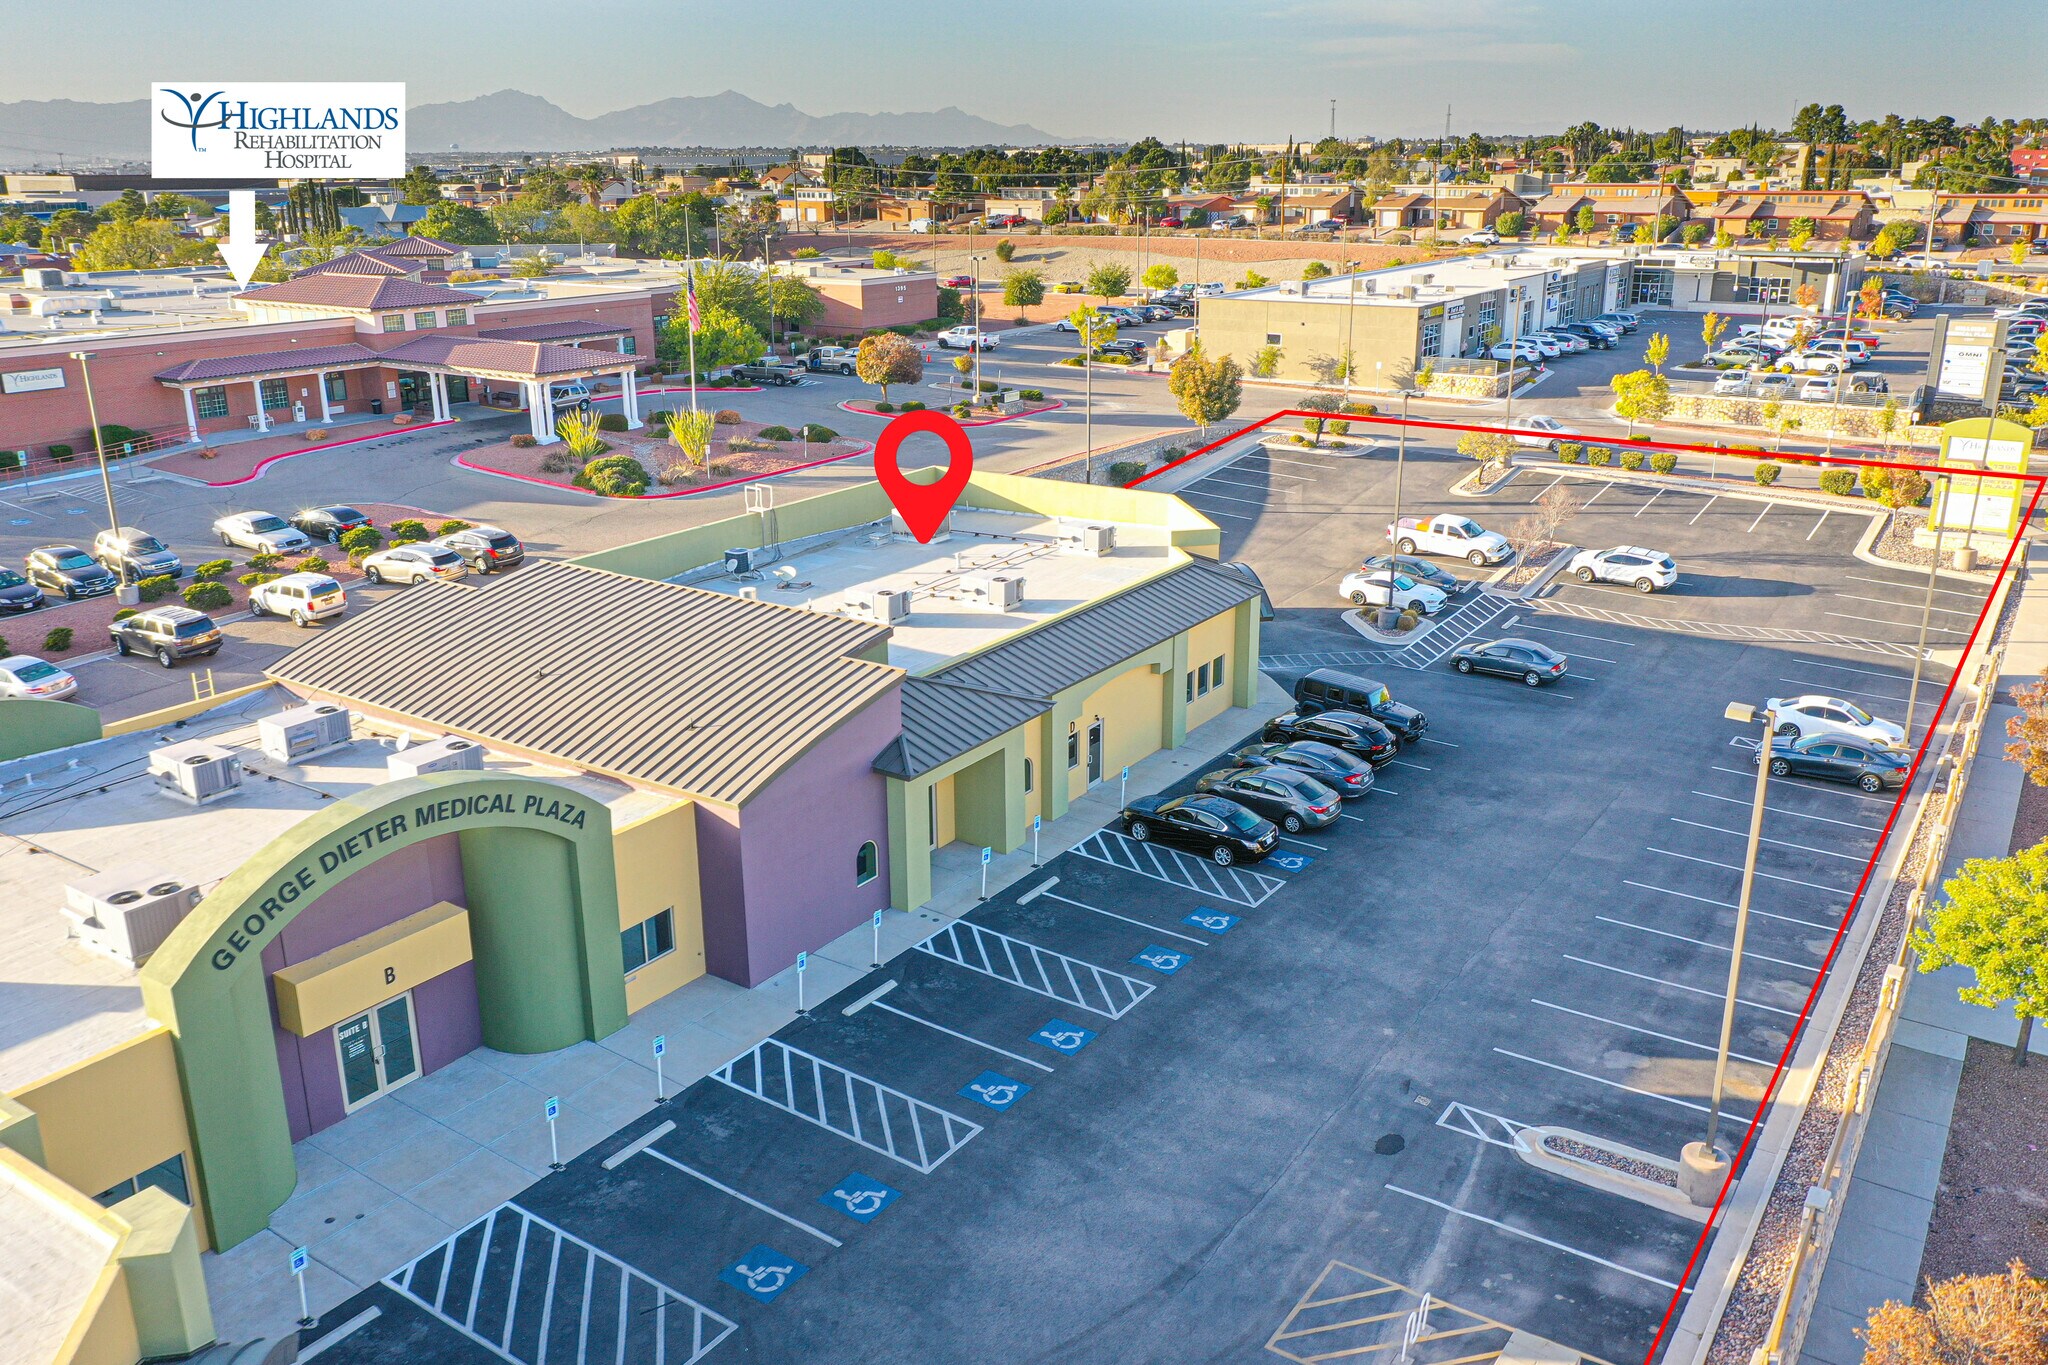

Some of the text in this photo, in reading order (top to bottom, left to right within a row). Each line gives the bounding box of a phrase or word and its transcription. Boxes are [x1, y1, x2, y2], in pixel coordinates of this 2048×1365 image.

[20, 373, 58, 382] HIGHLANDS
[1070, 721, 1075, 733] D
[211, 793, 587, 971] GEORGE DIETER MEDICAL PLAZA
[384, 967, 396, 985] B
[339, 1020, 368, 1040] SUITE B
